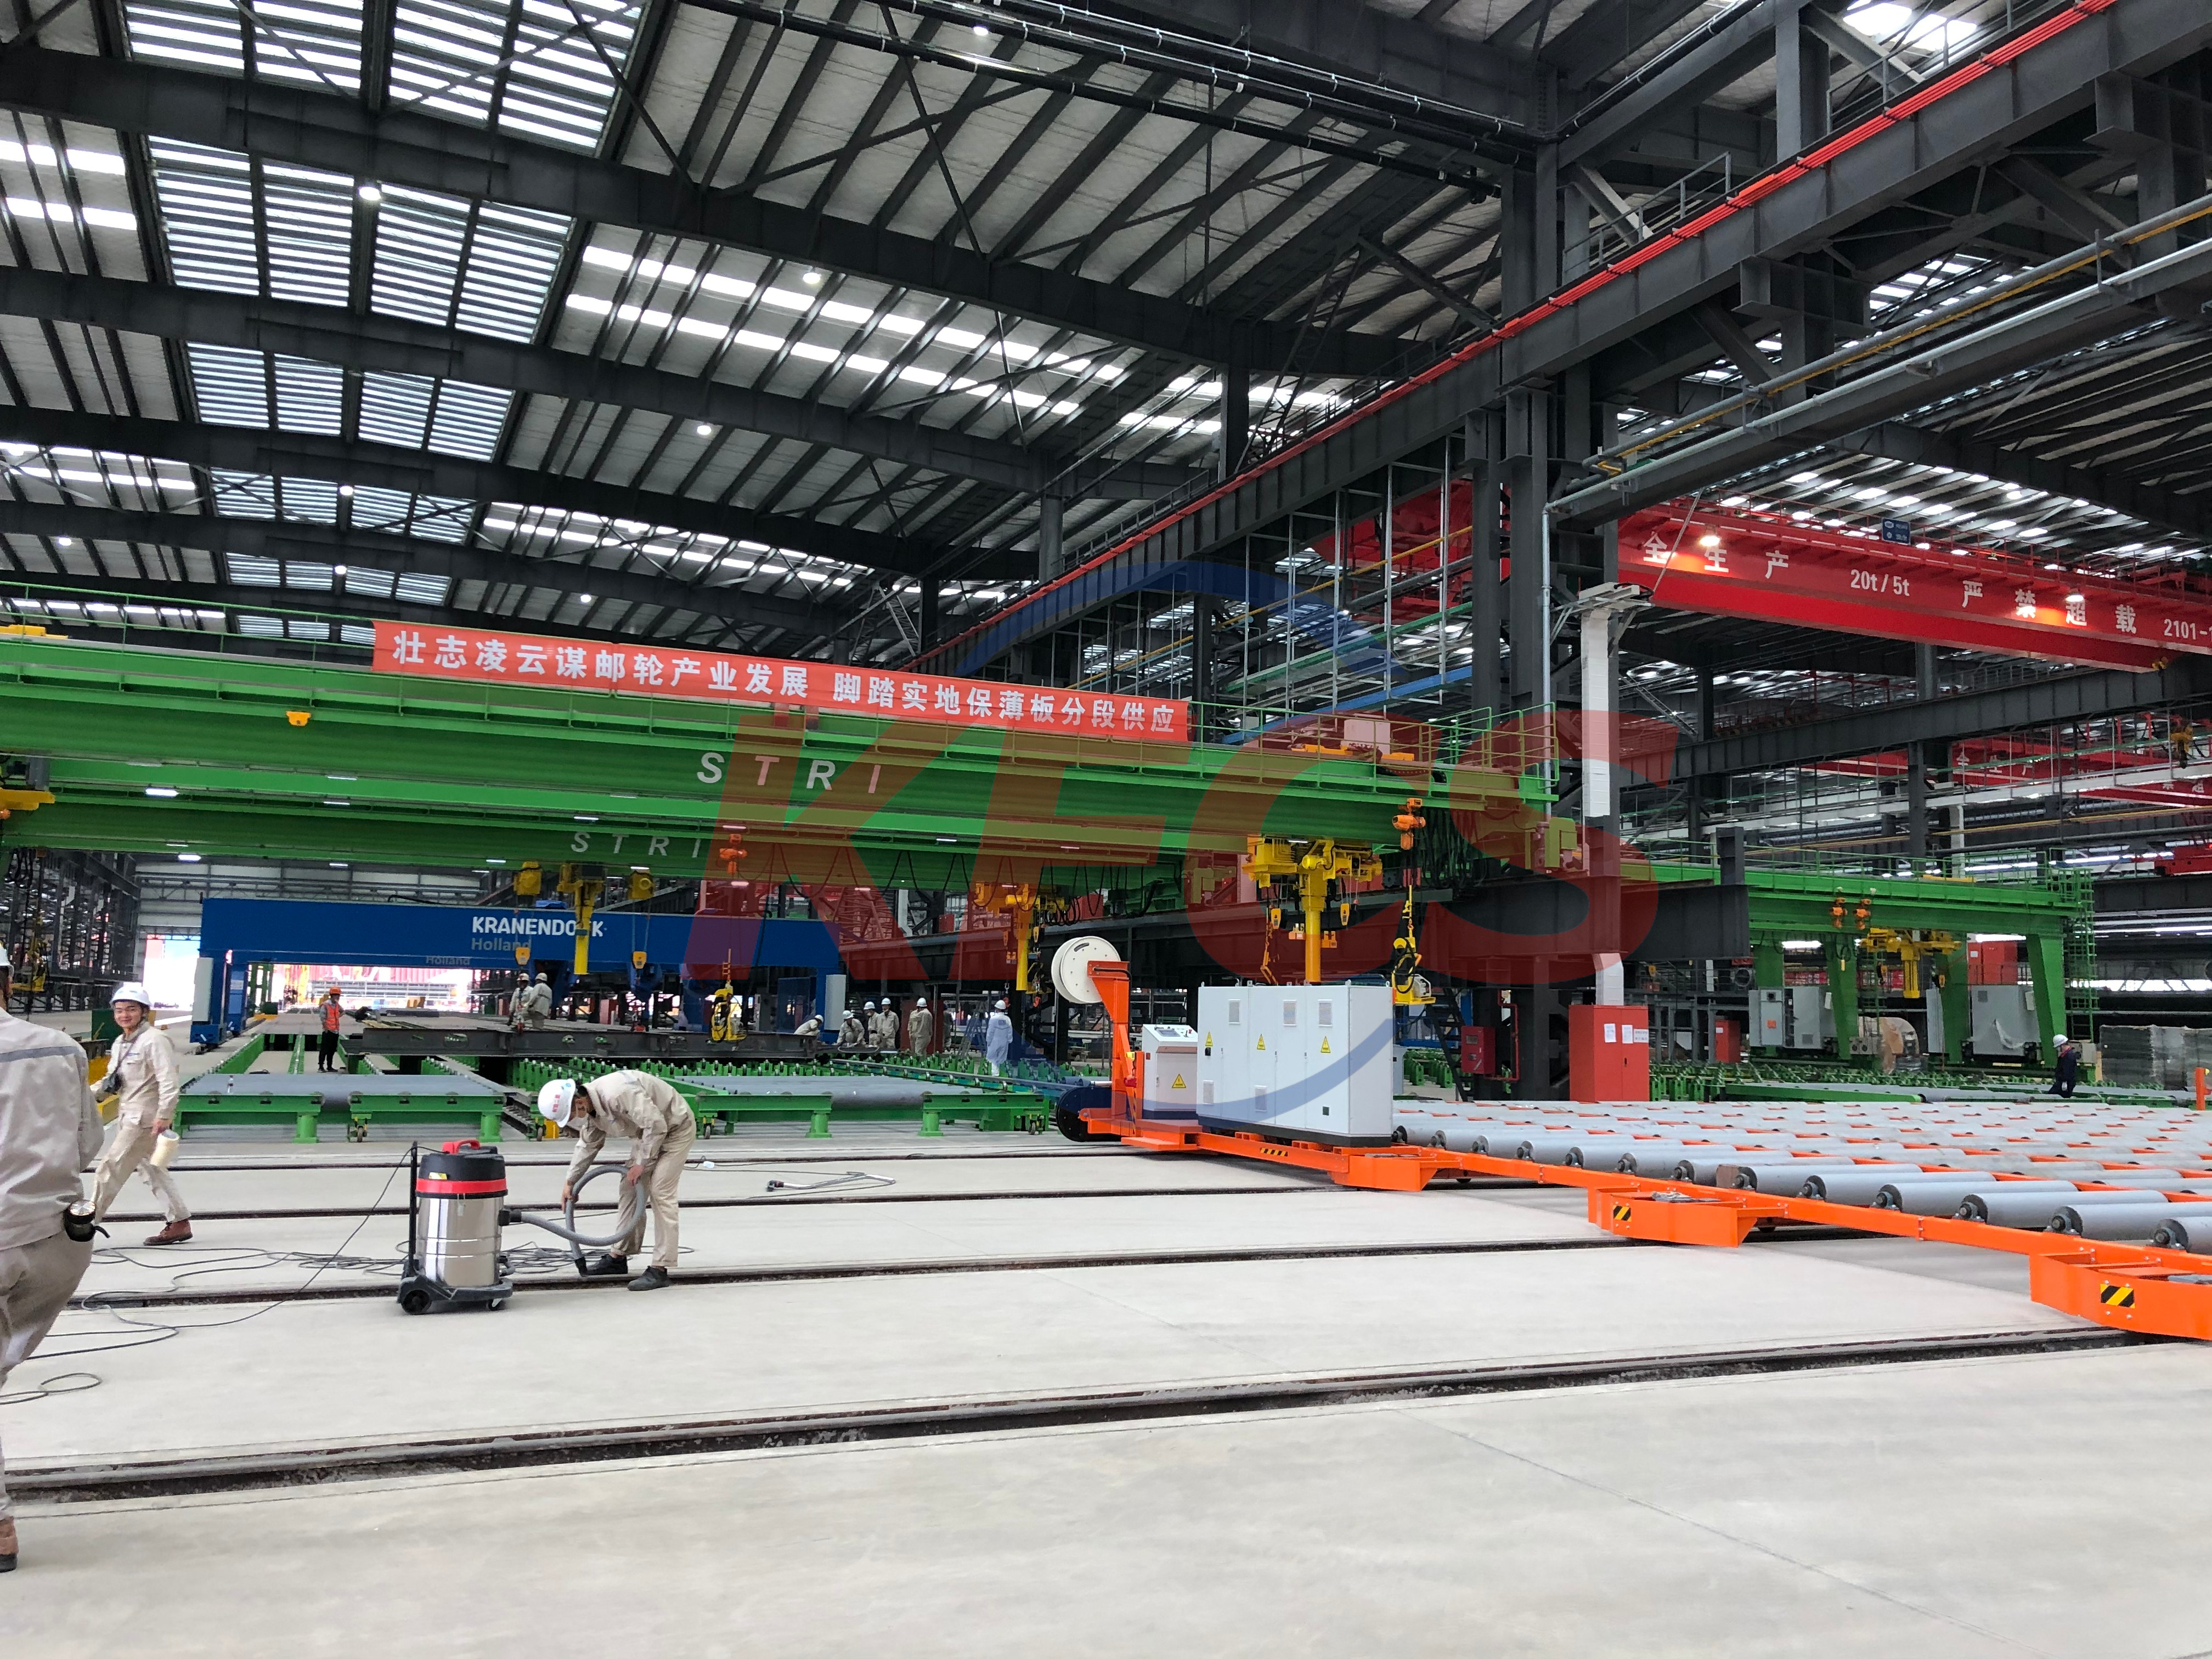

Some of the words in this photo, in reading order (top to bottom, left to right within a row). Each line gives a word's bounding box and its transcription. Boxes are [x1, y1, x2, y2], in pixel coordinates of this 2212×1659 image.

[1962, 580, 2137, 634] 严禁超载
[393, 630, 808, 698] 壮志凌云谋邮轮产业发展
[832, 672, 1175, 733] 脚踏实地保薄板分段供应
[697, 752, 881, 794] STRI
[571, 831, 701, 859] STRI
[472, 916, 603, 937] KRANENDOK
